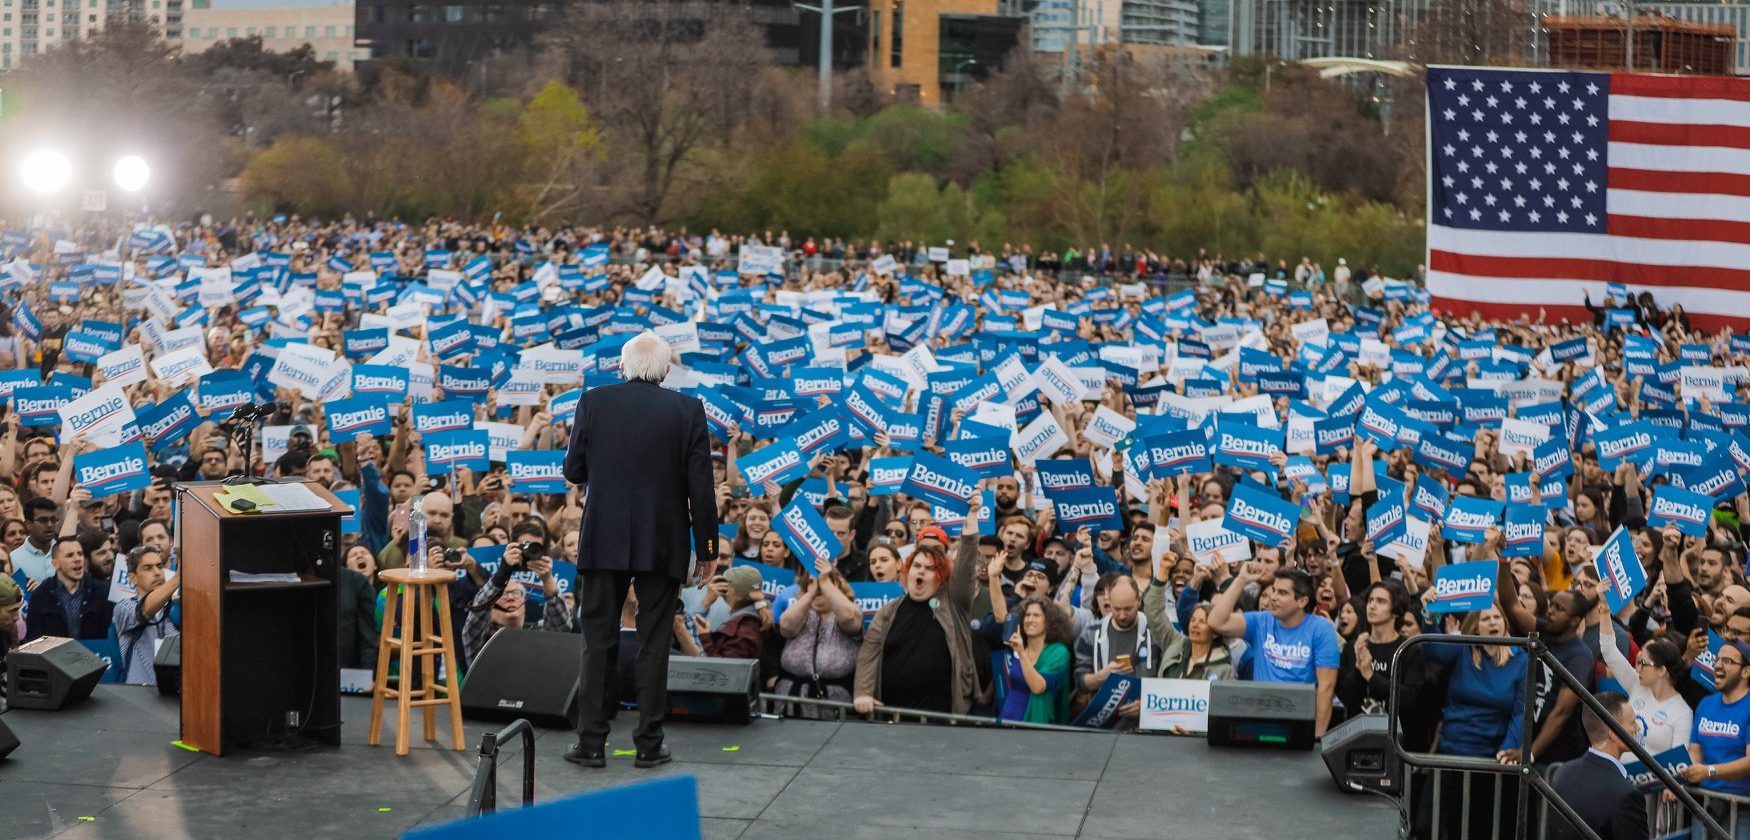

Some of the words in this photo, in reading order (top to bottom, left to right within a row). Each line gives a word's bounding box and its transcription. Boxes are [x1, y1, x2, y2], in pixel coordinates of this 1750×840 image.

[66, 337, 106, 353] Bernie
[347, 336, 387, 352] Bernie
[431, 329, 472, 352] Bernie
[474, 334, 498, 348] rnie
[560, 333, 599, 350] Bernie
[830, 329, 863, 345] Bernie
[599, 357, 622, 370] Ber
[746, 346, 768, 377] Bern
[767, 346, 806, 365] Bernie
[1064, 349, 1090, 367] ernie
[101, 356, 142, 378] Bernie
[158, 356, 203, 378] Bernie
[277, 361, 320, 387] Bernie
[535, 360, 579, 373] Bernie
[1628, 363, 1655, 376] Bern
[1657, 368, 1682, 384] Bern
[354, 374, 406, 392] Bernie
[409, 372, 434, 385] ernie
[442, 374, 490, 391] Bernie
[794, 377, 842, 393] Bernie
[863, 374, 903, 399] Bernie
[1004, 371, 1026, 392] rnie
[1080, 375, 1101, 388] nie
[1260, 379, 1301, 392] Bernie
[1570, 374, 1600, 397] Bernie
[1684, 374, 1721, 389] Bernie
[1723, 372, 1748, 383] ernie
[17, 398, 70, 412] Bernie
[202, 390, 252, 408] Bernie
[956, 380, 1000, 411] Bernie
[69, 395, 124, 431] Bernie
[330, 405, 386, 431] Bernie
[552, 400, 578, 415] Ber
[847, 390, 888, 431] Bernie
[922, 396, 942, 440] Bernie
[1161, 401, 1201, 424] Bernie
[1464, 405, 1507, 421] Bernie
[141, 403, 191, 437] Bernie
[416, 411, 471, 430] Bernie
[1093, 415, 1128, 438] Bern
[1361, 406, 1398, 436] Bernie
[1720, 411, 1747, 426] Bernie
[266, 436, 290, 450] Ber
[489, 434, 519, 450] rnie
[1018, 422, 1057, 458] Bernie
[1219, 432, 1280, 456] Bernie
[1291, 428, 1313, 440] Ber
[1318, 426, 1351, 444] Bern
[1503, 428, 1544, 448] Bernie
[1599, 431, 1651, 455] Bernie
[429, 441, 486, 462] Bernie
[950, 447, 1007, 466] Bernie
[1151, 441, 1207, 463] Bernie
[1421, 440, 1467, 468] Bernie
[1535, 446, 1569, 474] Bernie
[1656, 448, 1703, 466] Bernie
[1728, 438, 1750, 468] Bern
[80, 455, 144, 484] Bernie
[510, 462, 565, 479] Bernie
[744, 450, 800, 482] Bernie
[873, 467, 908, 481] Bern
[911, 463, 976, 499] Bernie
[1041, 470, 1091, 487] Bernie
[1690, 468, 1737, 495] Bernie
[1057, 499, 1116, 518] Bernie
[1231, 497, 1292, 534] Bernie
[1368, 502, 1403, 536] Bernie
[1449, 507, 1495, 528] Bernie
[1653, 496, 1707, 524] Bernie
[785, 505, 831, 561] Bernie
[1505, 518, 1543, 539] Bernie
[1192, 532, 1243, 552] Bernie
[1399, 529, 1423, 550] nie
[1605, 539, 1633, 601] Bernie
[762, 579, 786, 595] nie
[1435, 573, 1492, 595] Bernie
[854, 594, 894, 611] erni
[1264, 633, 1311, 659] Bernie
[1274, 659, 1293, 671] 2020
[1087, 678, 1131, 728] Bernie
[1146, 692, 1208, 713] Bernie
[1698, 716, 1740, 737] Bernie
